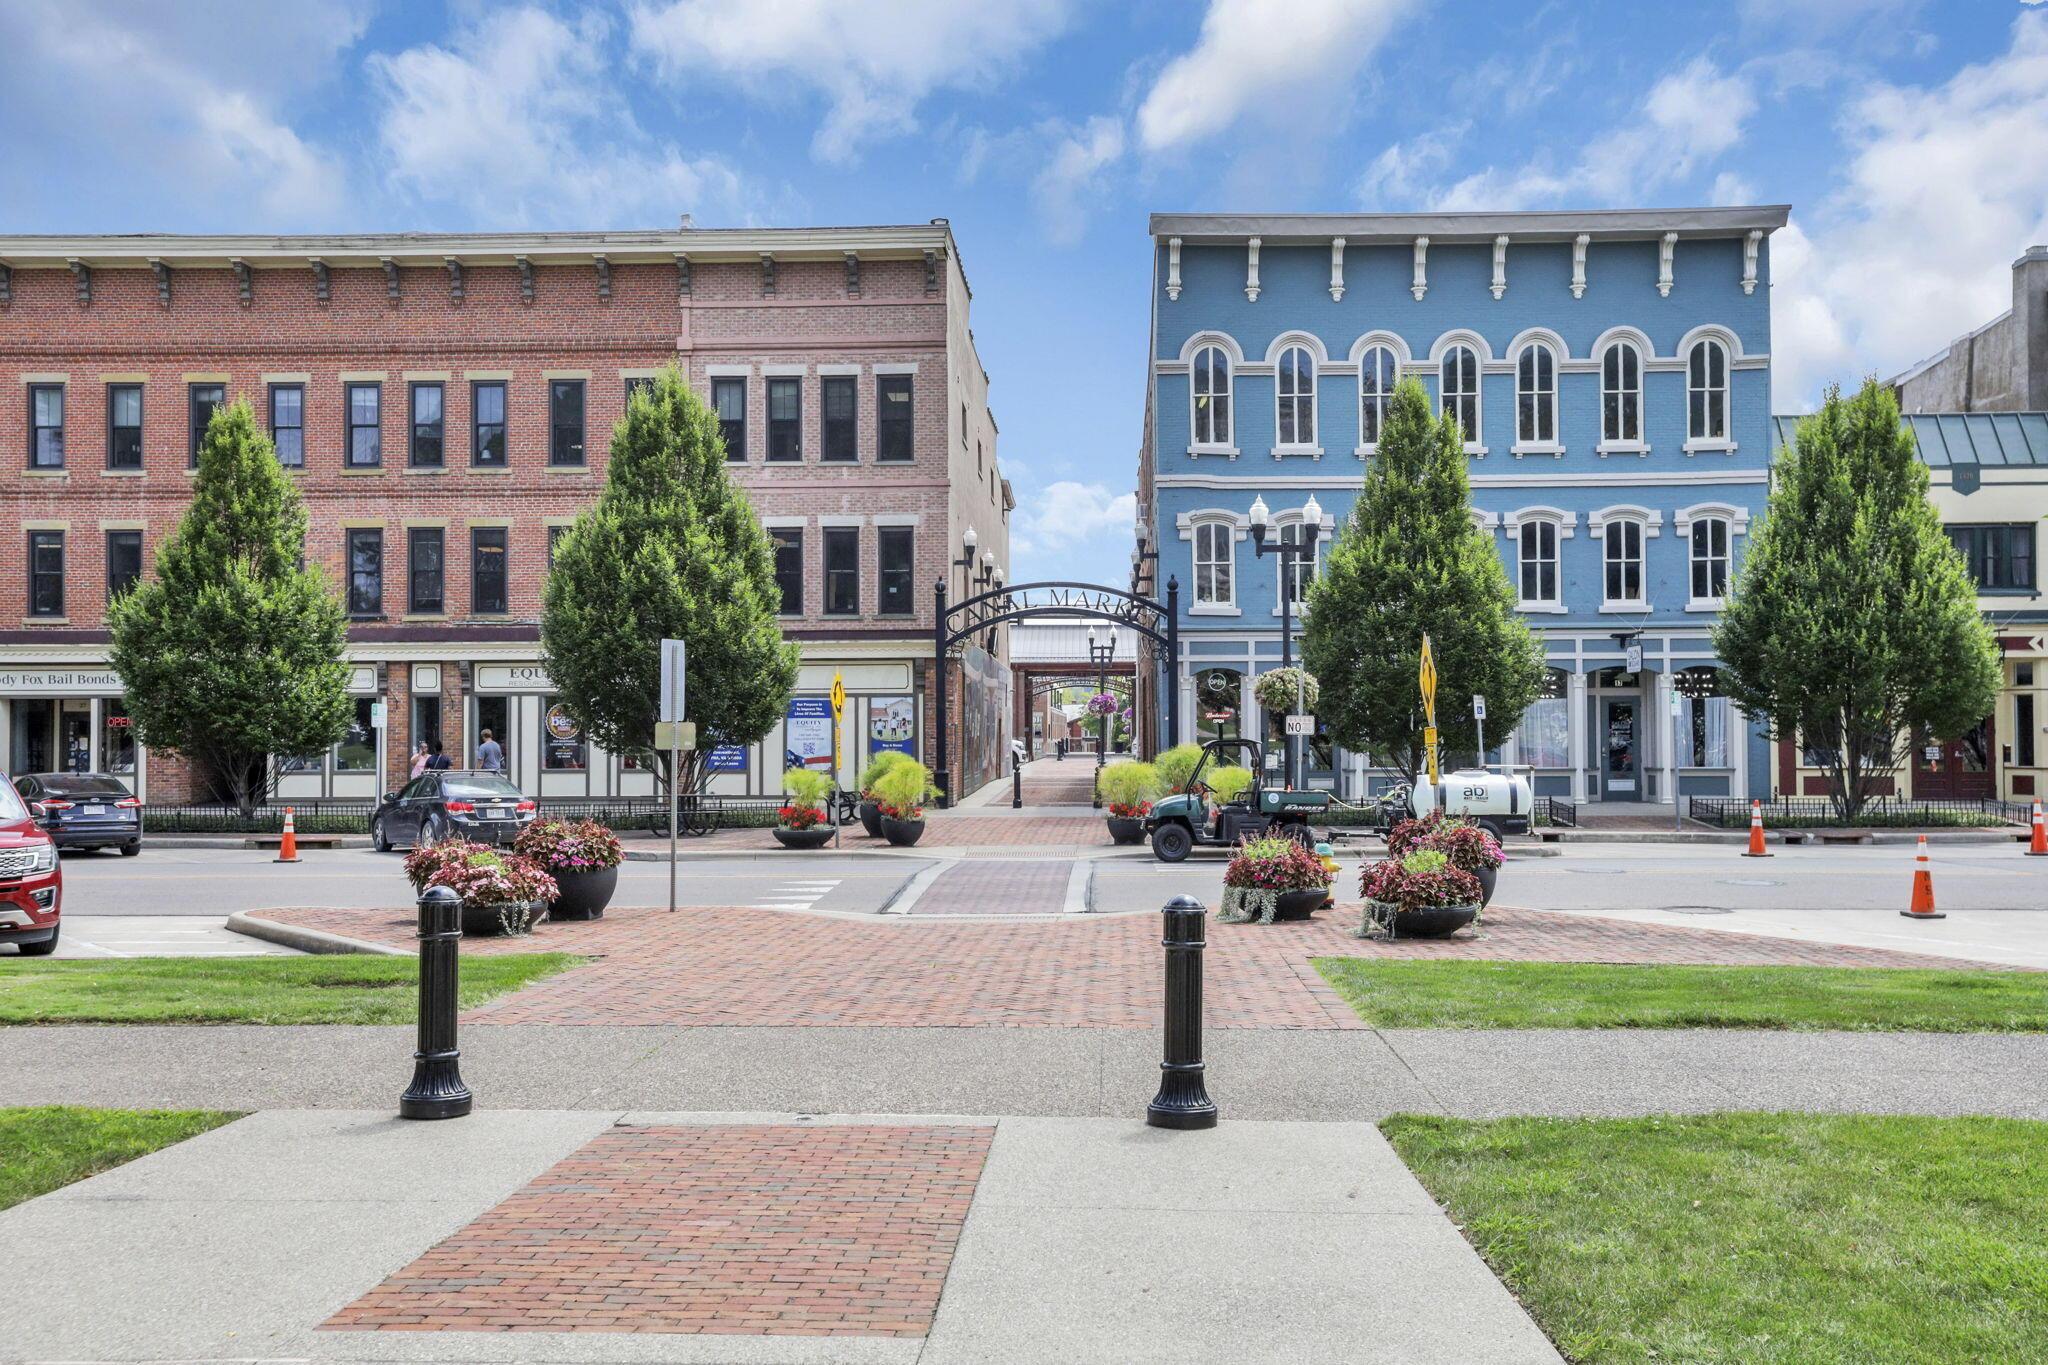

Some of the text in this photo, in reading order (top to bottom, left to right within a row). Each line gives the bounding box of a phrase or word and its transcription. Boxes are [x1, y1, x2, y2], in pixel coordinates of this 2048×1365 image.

[946, 588, 1167, 634] CANAL MARKET
[22, 674, 43, 685] Fox
[48, 674, 73, 685] Bail
[77, 674, 117, 685] Bonds
[510, 668, 545, 680] EQU
[1210, 678, 1226, 686] OPEN
[1287, 722, 1302, 733] NO
